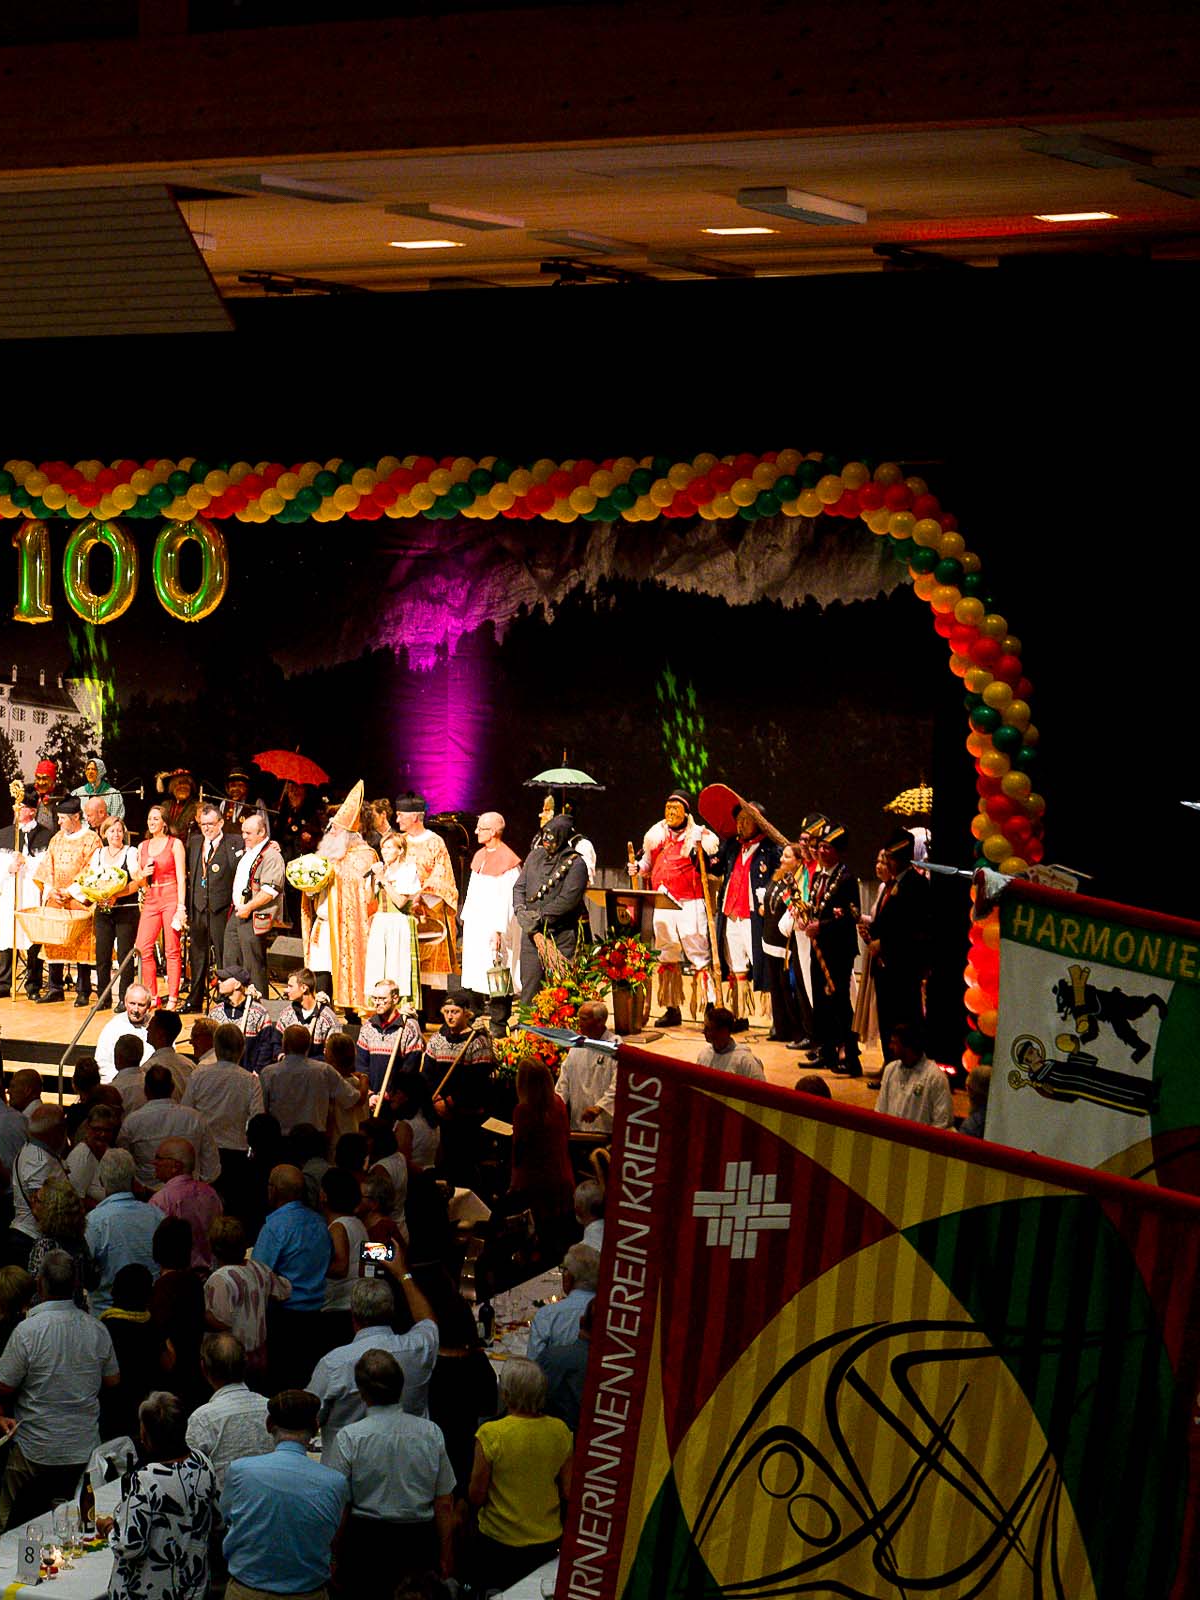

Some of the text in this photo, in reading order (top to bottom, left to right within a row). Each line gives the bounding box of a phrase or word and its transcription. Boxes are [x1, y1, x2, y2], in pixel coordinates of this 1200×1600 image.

[11, 519, 229, 624] 100
[1012, 905, 1200, 979] HARMONIE
[567, 1072, 662, 1600] RNERINNENVEREIN KRIENS
[24, 1546, 35, 1564] 8
